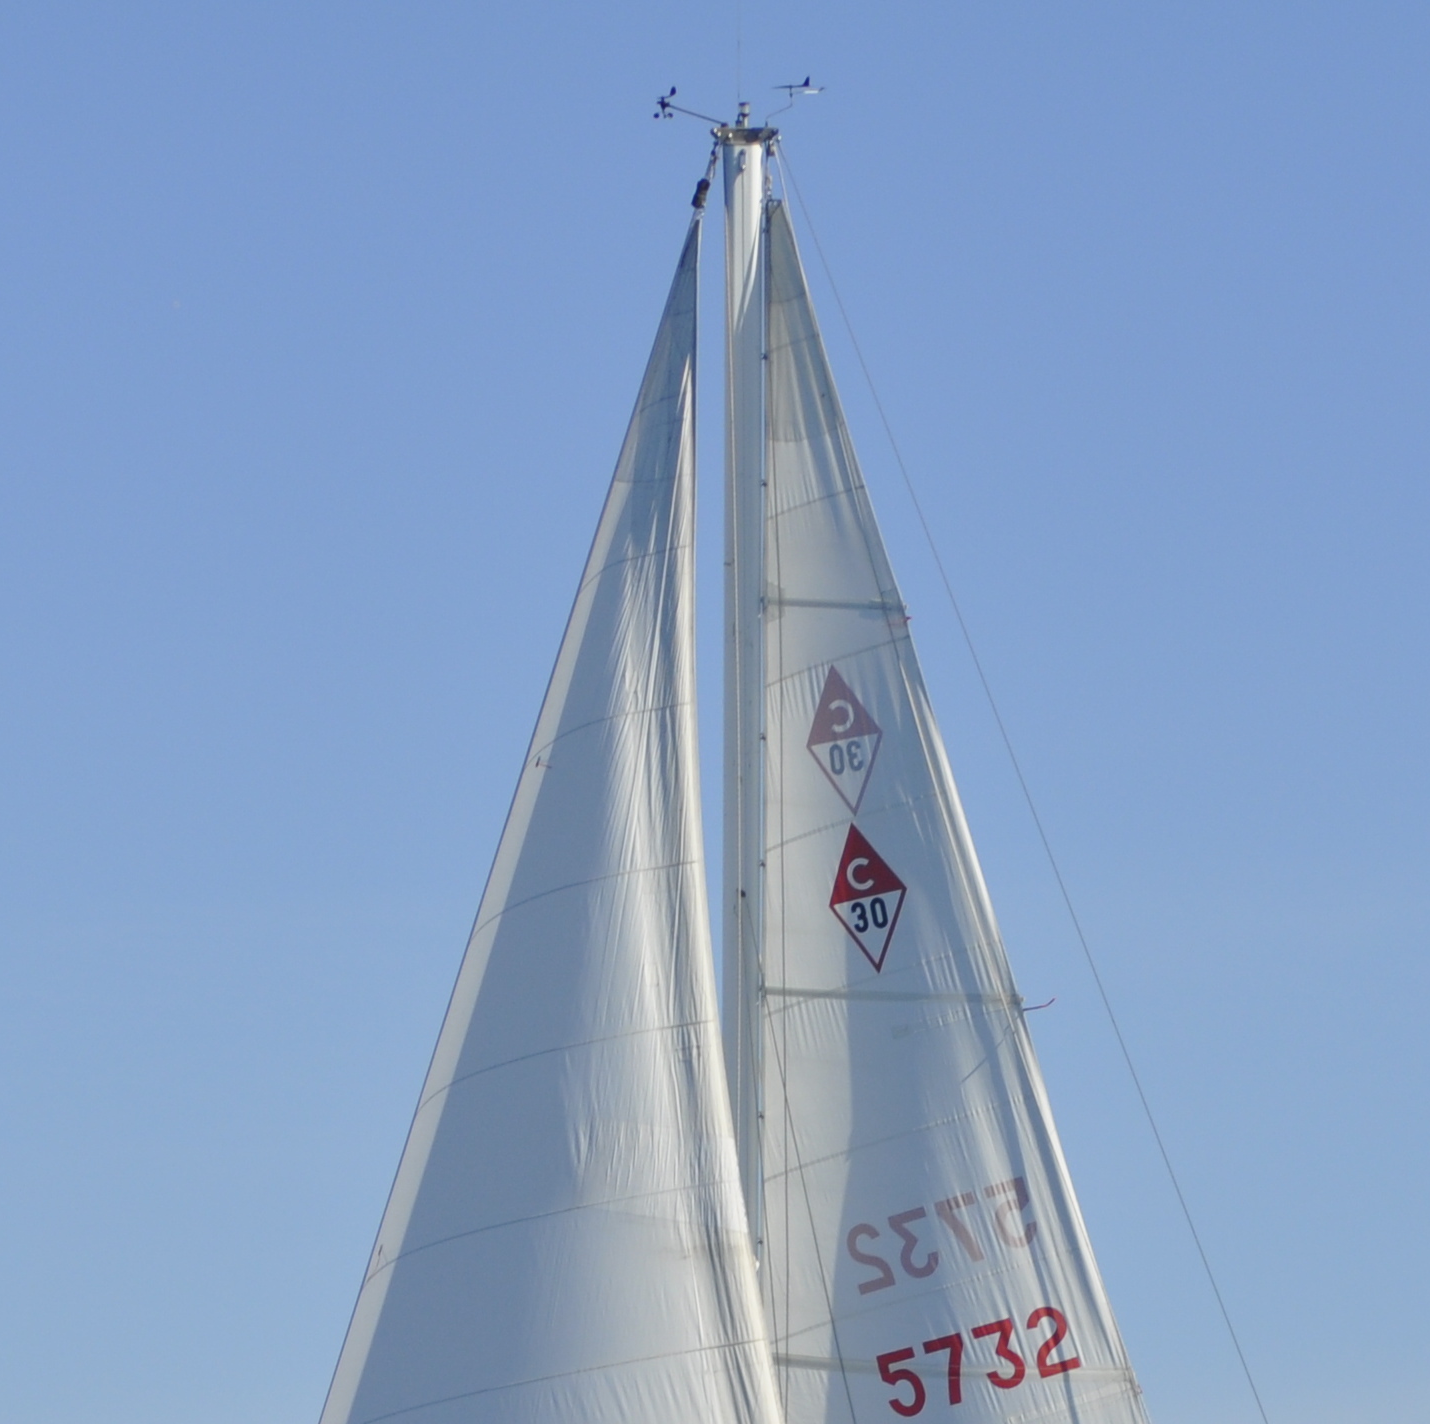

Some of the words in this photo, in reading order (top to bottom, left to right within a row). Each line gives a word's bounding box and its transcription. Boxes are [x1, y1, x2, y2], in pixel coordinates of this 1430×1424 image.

[846, 857, 875, 891] C
[850, 896, 889, 934] 30
[875, 1306, 1082, 1417] 5732
